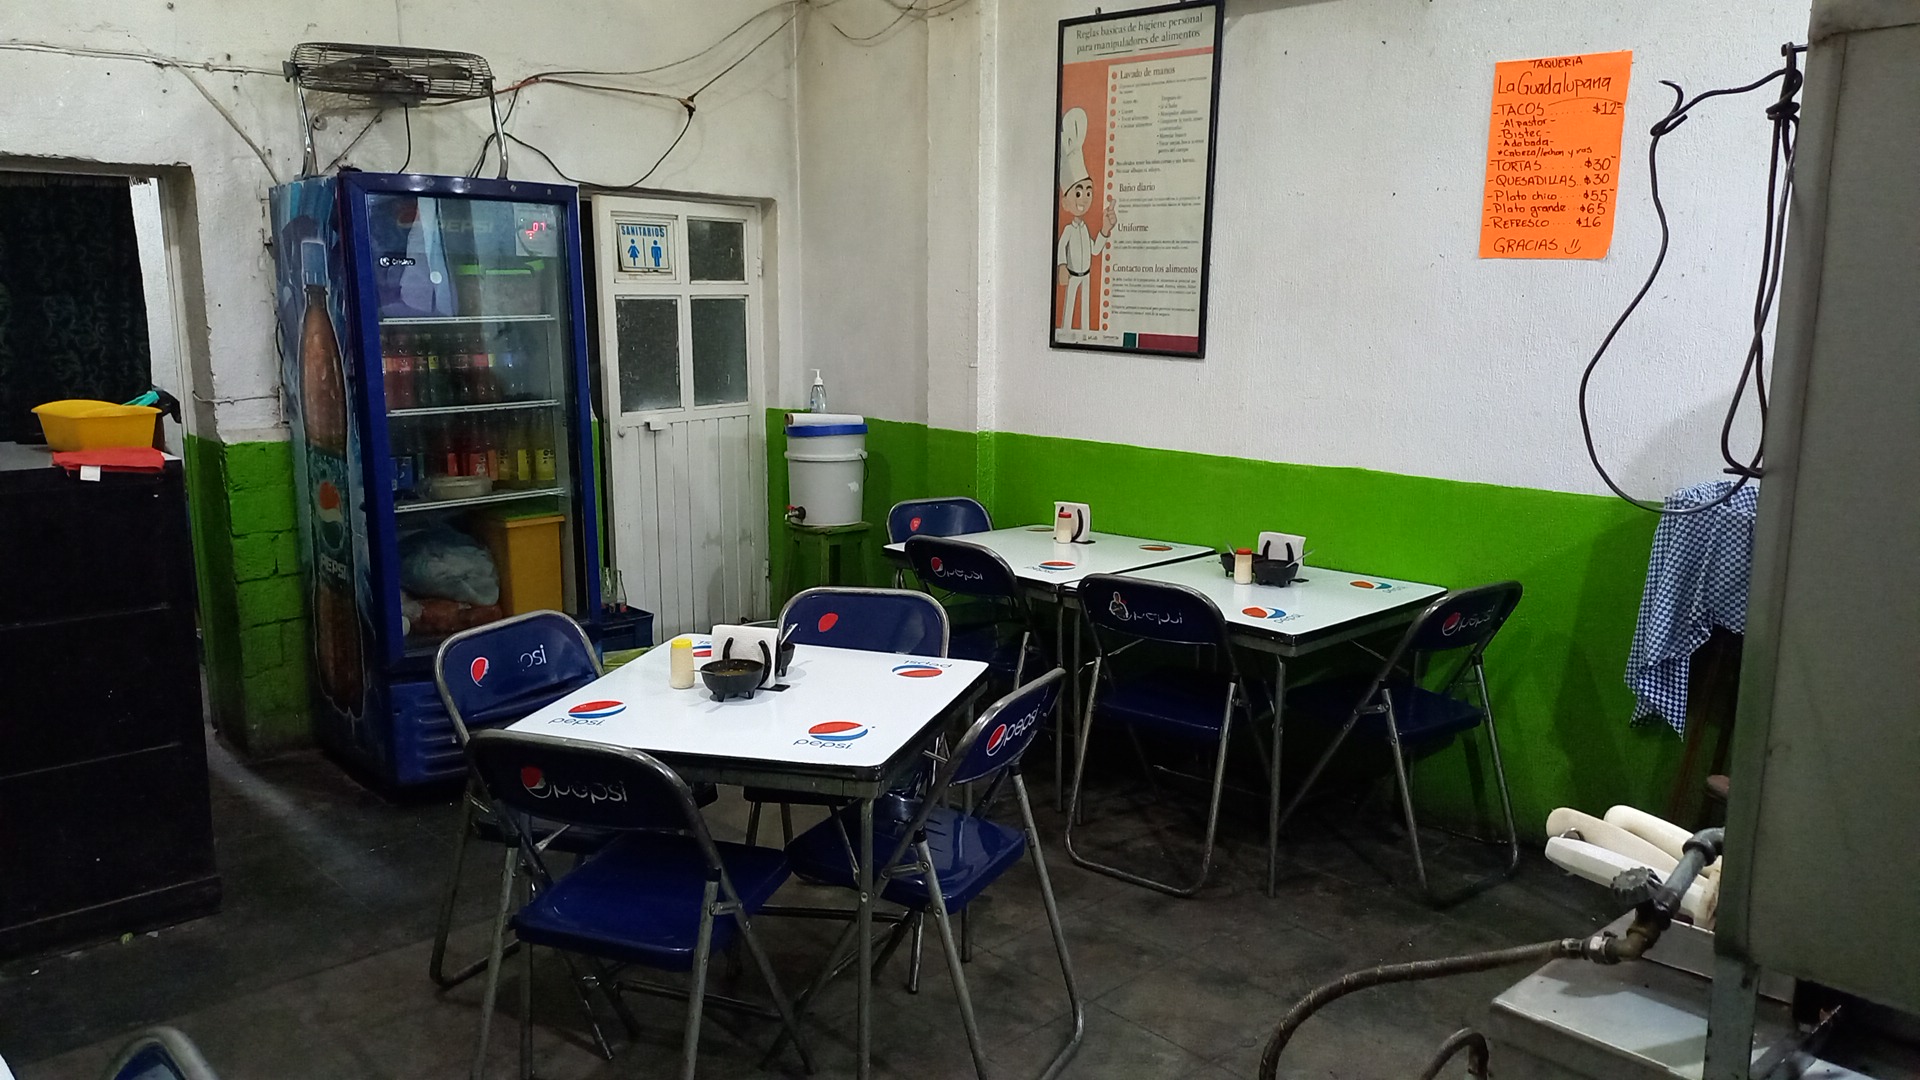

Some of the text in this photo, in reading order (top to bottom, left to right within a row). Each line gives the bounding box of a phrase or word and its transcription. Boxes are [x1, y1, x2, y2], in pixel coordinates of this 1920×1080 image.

[1076, 28, 1100, 40] Reglas
[1127, 22, 1137, 33] de
[1138, 18, 1167, 32] higiene
[1168, 12, 1203, 28] personal
[1076, 29, 1200, 55] para manipuladores de alimentos
[1528, 55, 1583, 69] TAQUERIA
[1120, 67, 1176, 79] Lavado de manos
[1497, 71, 1612, 97] La Guadalupana
[1516, 115, 1547, 128] pastor
[1567, 150, 1574, 158] y
[1583, 173, 1610, 186] $30
[1531, 190, 1557, 201] chico
[1530, 201, 1566, 218] grande
[1579, 202, 1606, 216] $65
[1117, 222, 1149, 233] Uniforme
[1576, 215, 1602, 228] $16
[621, 226, 665, 237] SANITARIOS
[1493, 236, 1558, 254] GRACIAS
[1112, 263, 1199, 274] Contacto con los alimentos
[548, 717, 606, 726] pepsi
[1003, 703, 1041, 747] pepsi
[793, 738, 853, 750] pepsi
[553, 780, 628, 804] pepsi
